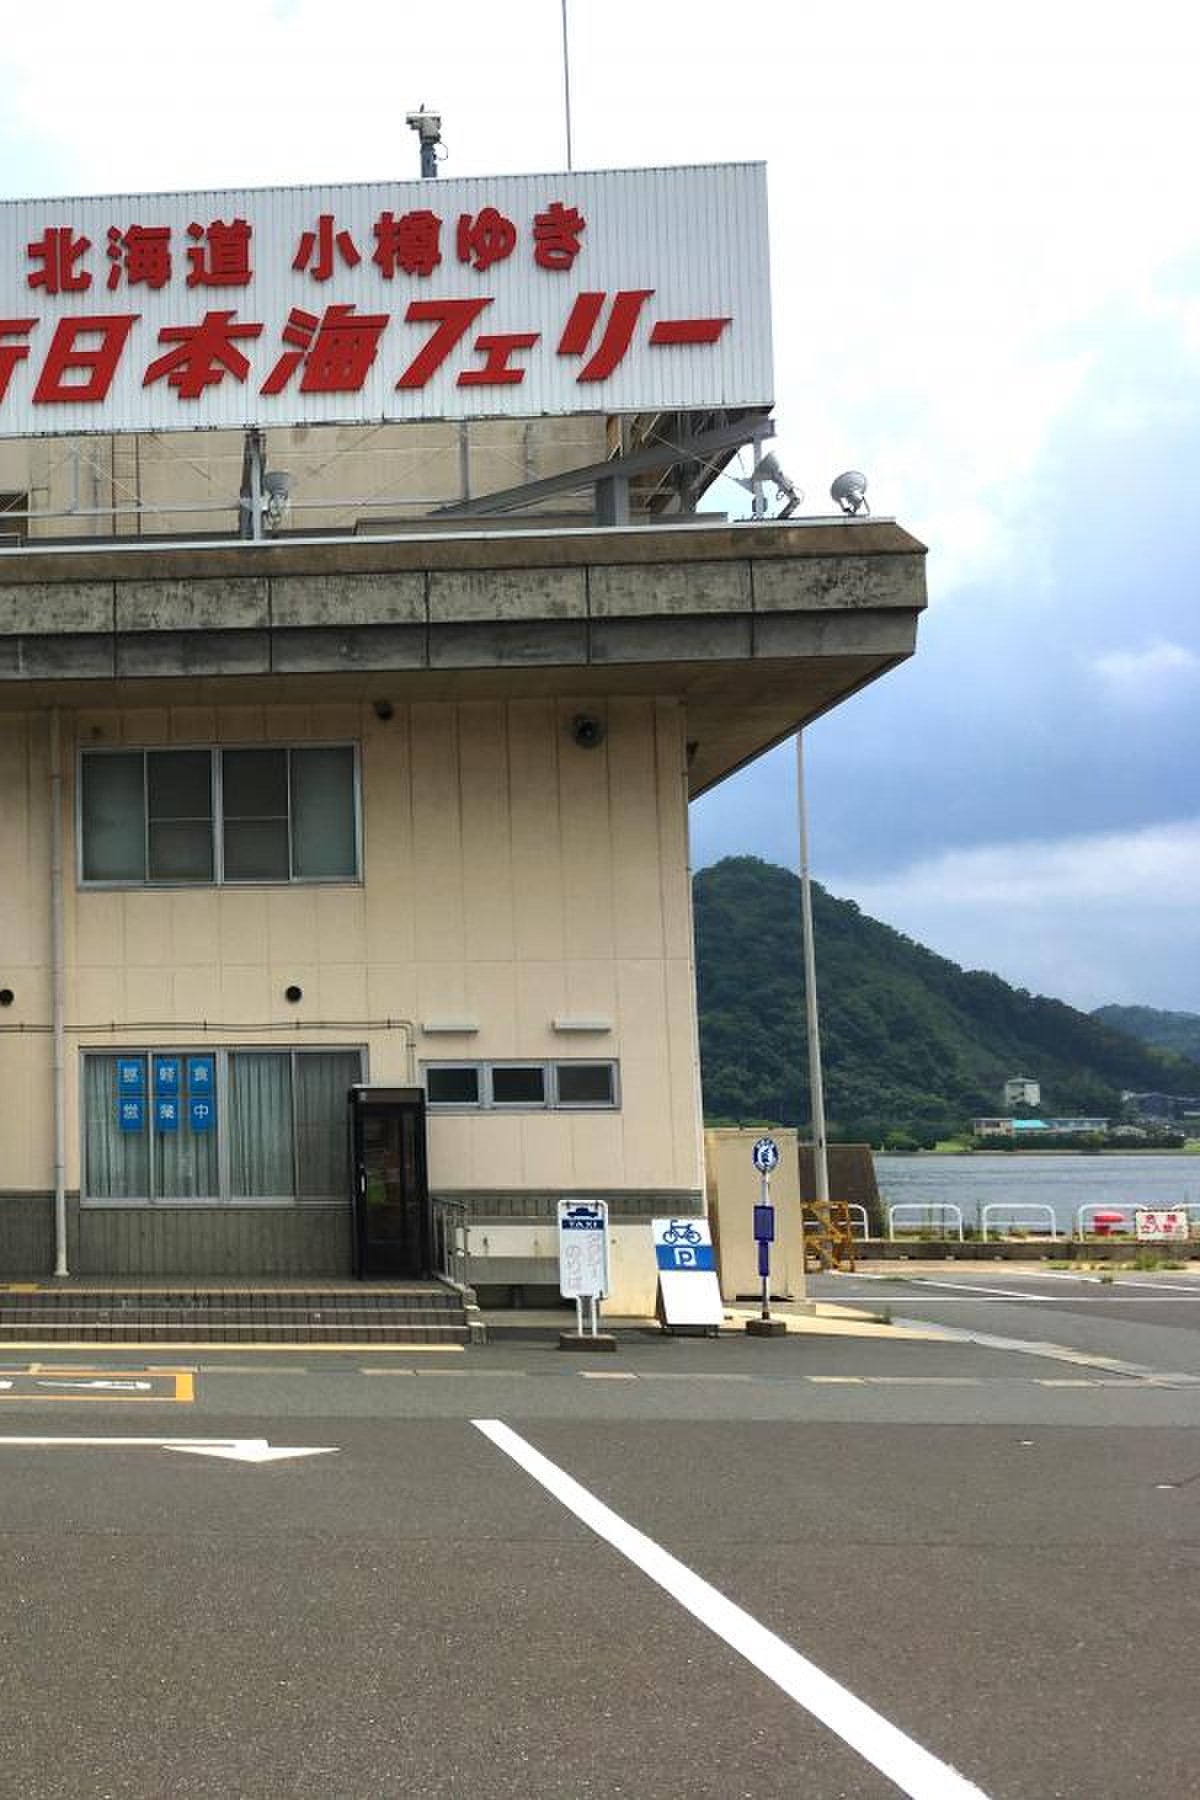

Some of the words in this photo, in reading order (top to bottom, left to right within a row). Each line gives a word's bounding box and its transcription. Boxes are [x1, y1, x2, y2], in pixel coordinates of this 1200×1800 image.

[26, 219, 253, 295] 北海道
[292, 202, 587, 282] 小樽ゆき
[569, 1220, 598, 1230] TAXI
[678, 1250, 693, 1264] P
